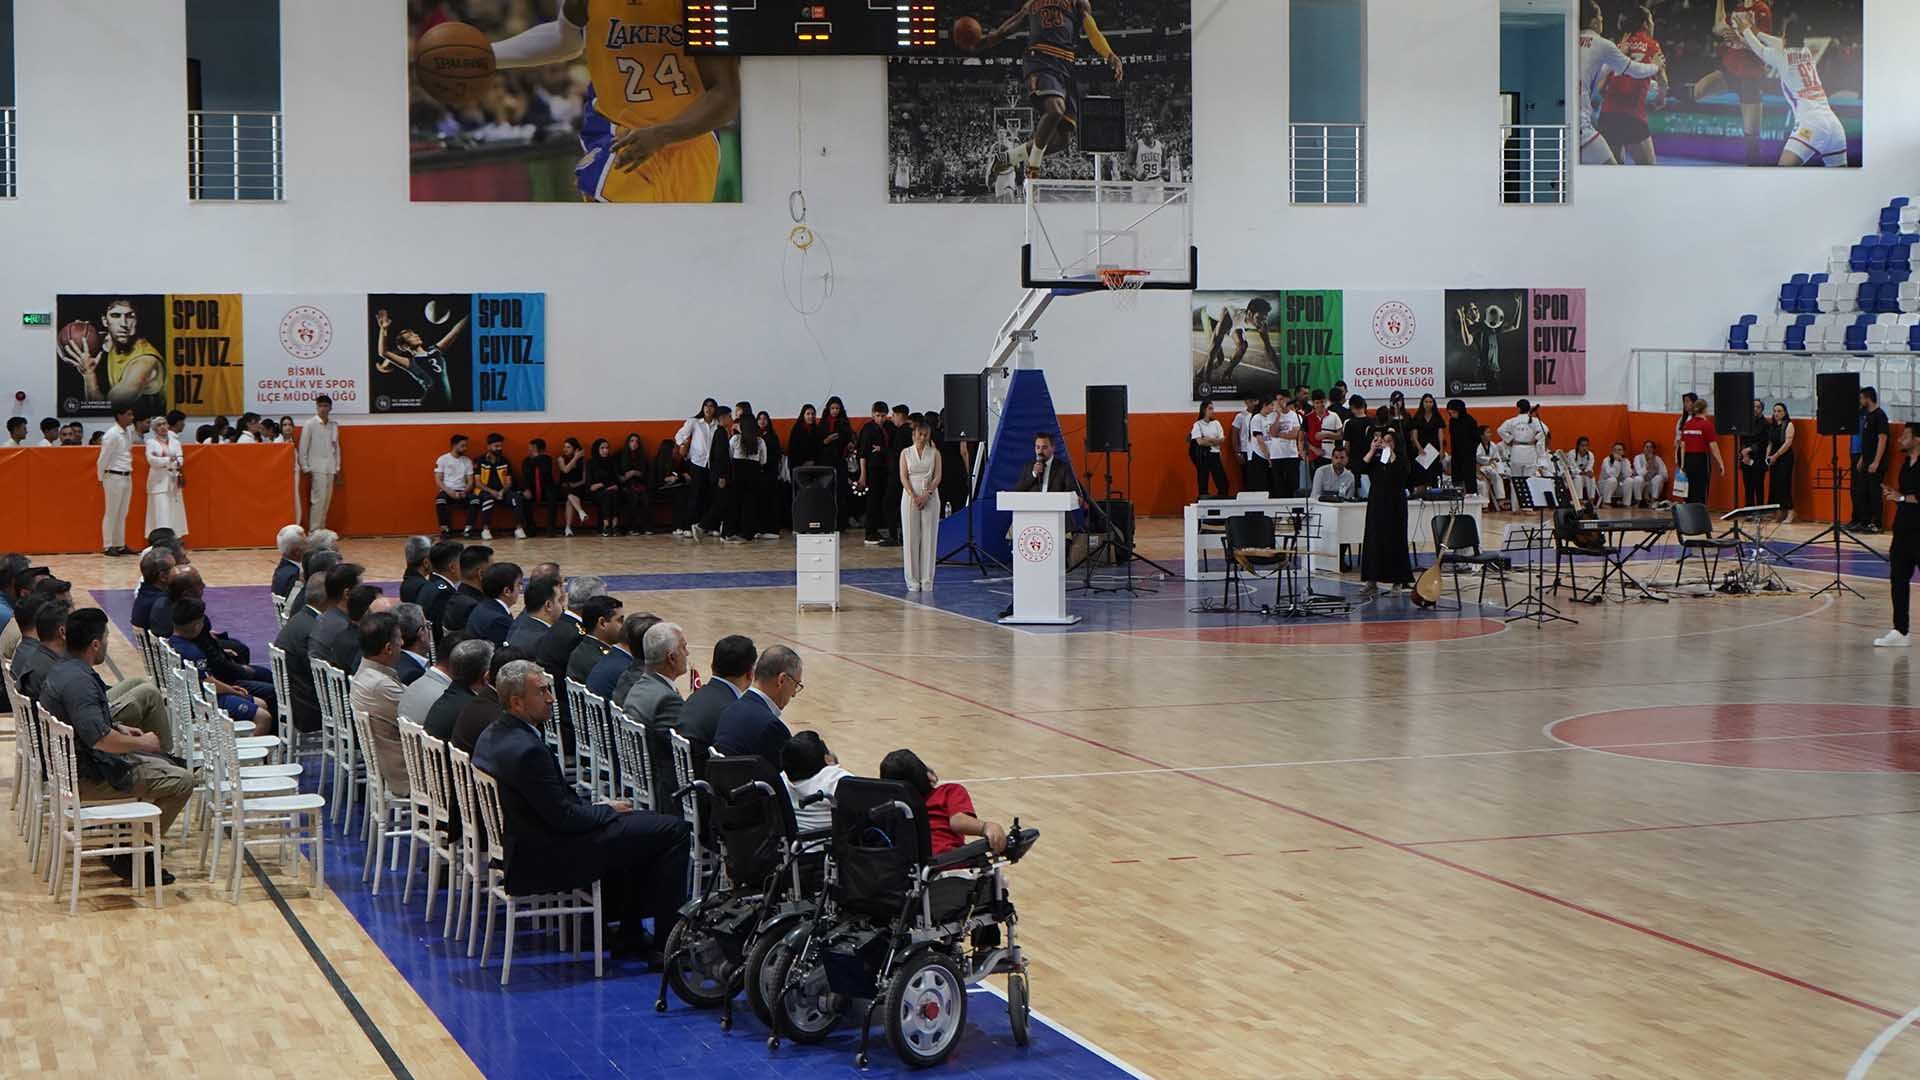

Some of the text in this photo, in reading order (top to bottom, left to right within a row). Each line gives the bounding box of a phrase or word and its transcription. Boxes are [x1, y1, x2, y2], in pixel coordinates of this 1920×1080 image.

[606, 18, 684, 49] LAKERS
[616, 53, 690, 103] 24
[173, 300, 218, 329] SPOR
[479, 299, 522, 328] SPOR
[1287, 296, 1323, 321] SPOR
[1534, 294, 1568, 320] SPOR
[430, 358, 442, 373] 3
[1378, 354, 1409, 364] BİSMİL
[287, 365, 326, 376] BİSMİL
[1355, 366, 1433, 377] GENÇLİK VE SPOR
[258, 379, 355, 391] GENÇLİK VE SPOR
[1354, 377, 1434, 389] İLÇE MÜDÜRLÜĞÜ
[257, 391, 281, 404] İLÇE
